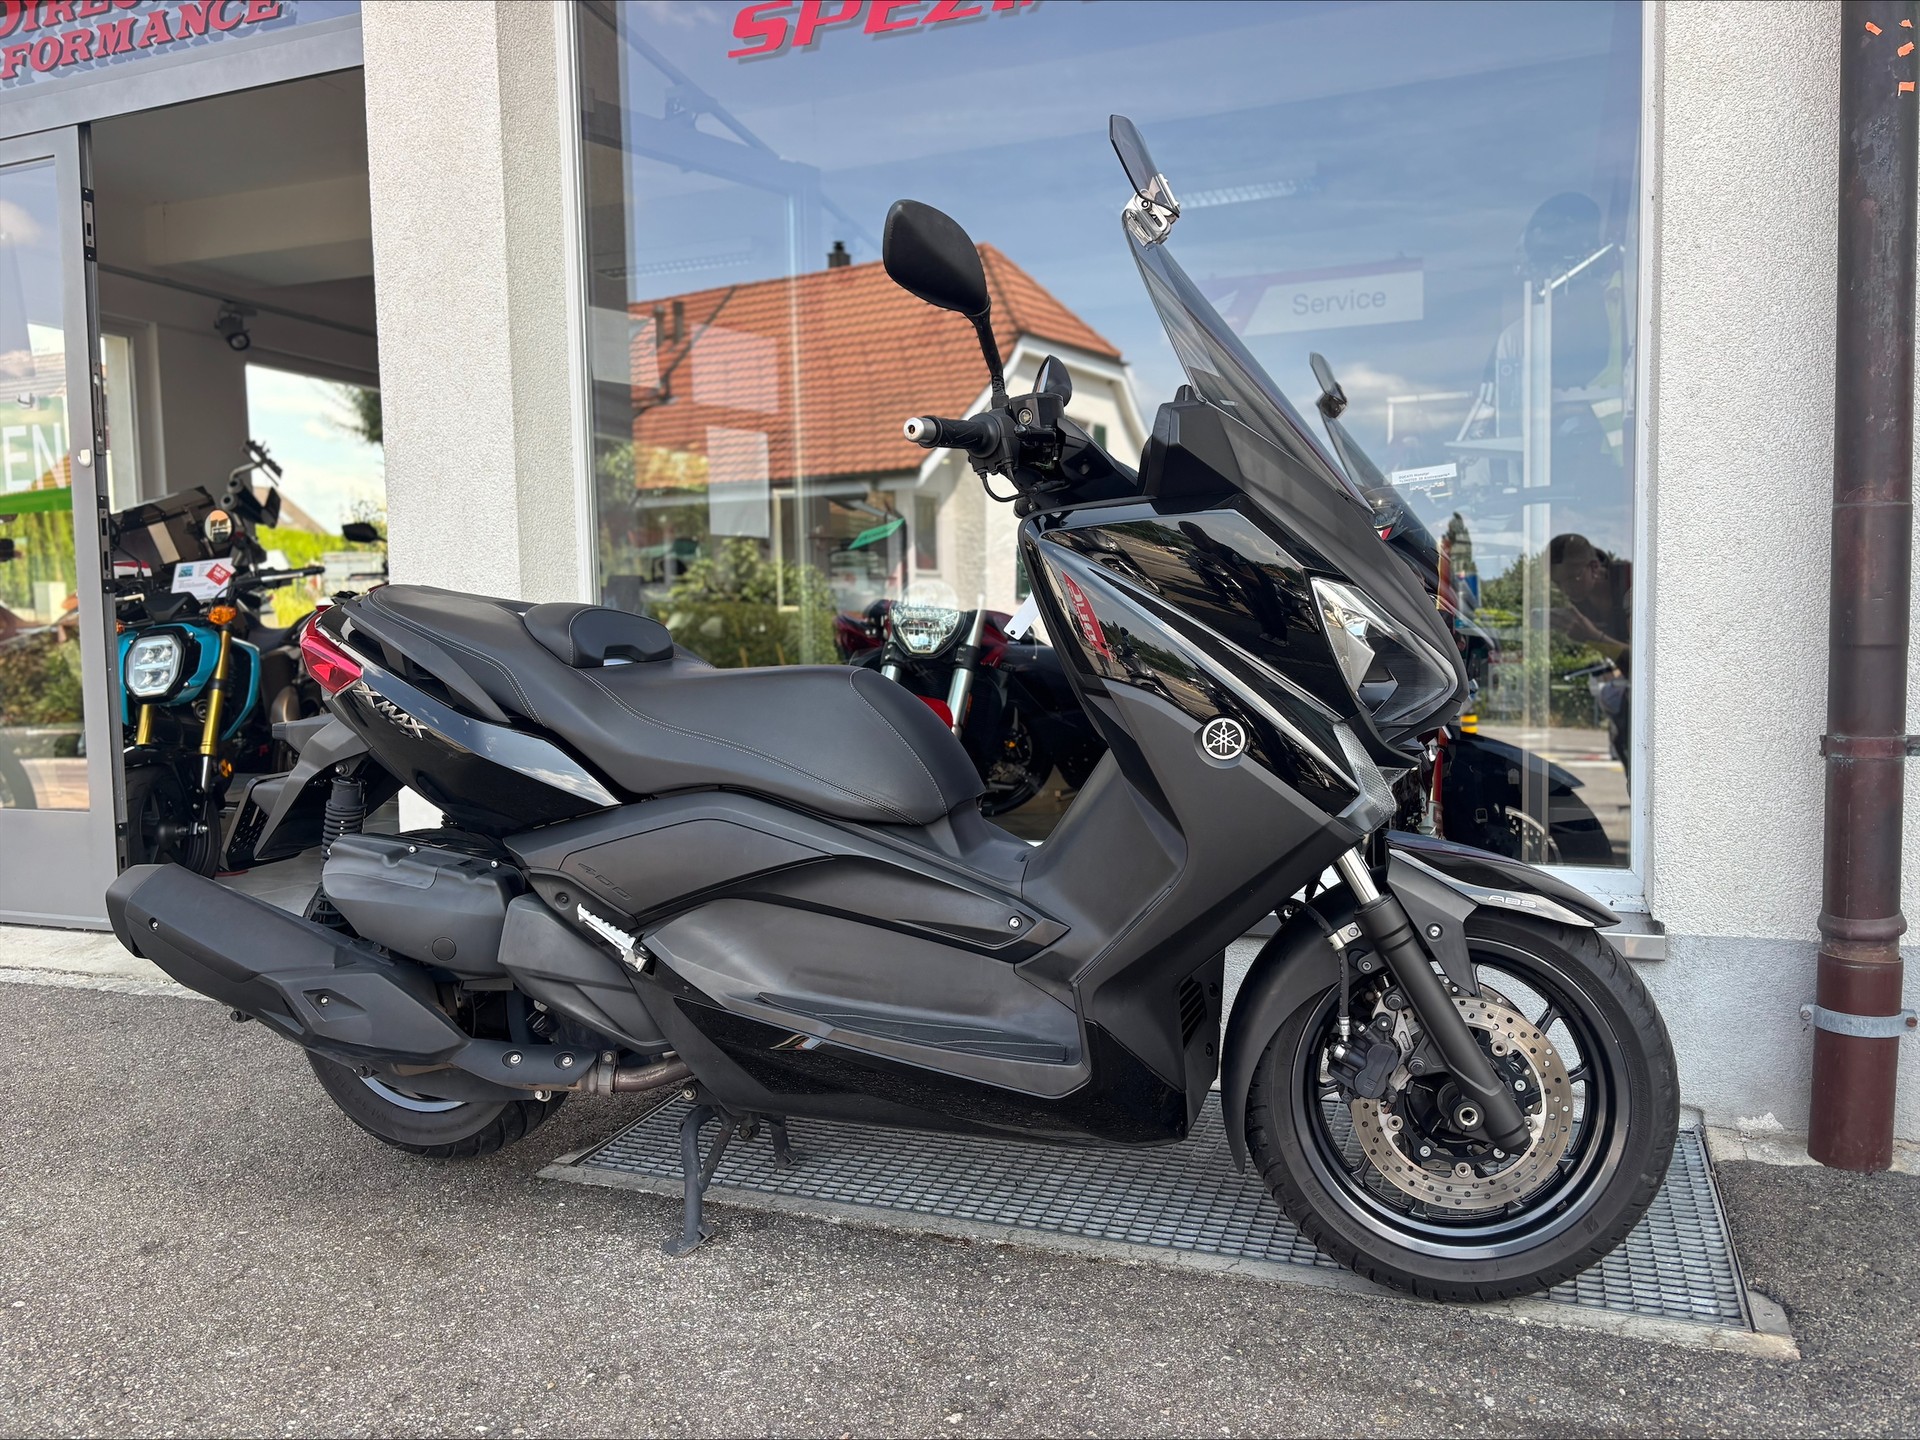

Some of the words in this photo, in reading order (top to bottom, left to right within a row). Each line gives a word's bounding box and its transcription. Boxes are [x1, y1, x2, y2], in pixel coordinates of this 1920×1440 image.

[1292, 289, 1387, 316] Service
[577, 862, 633, 901] 400
[1488, 894, 1537, 909] ABS
